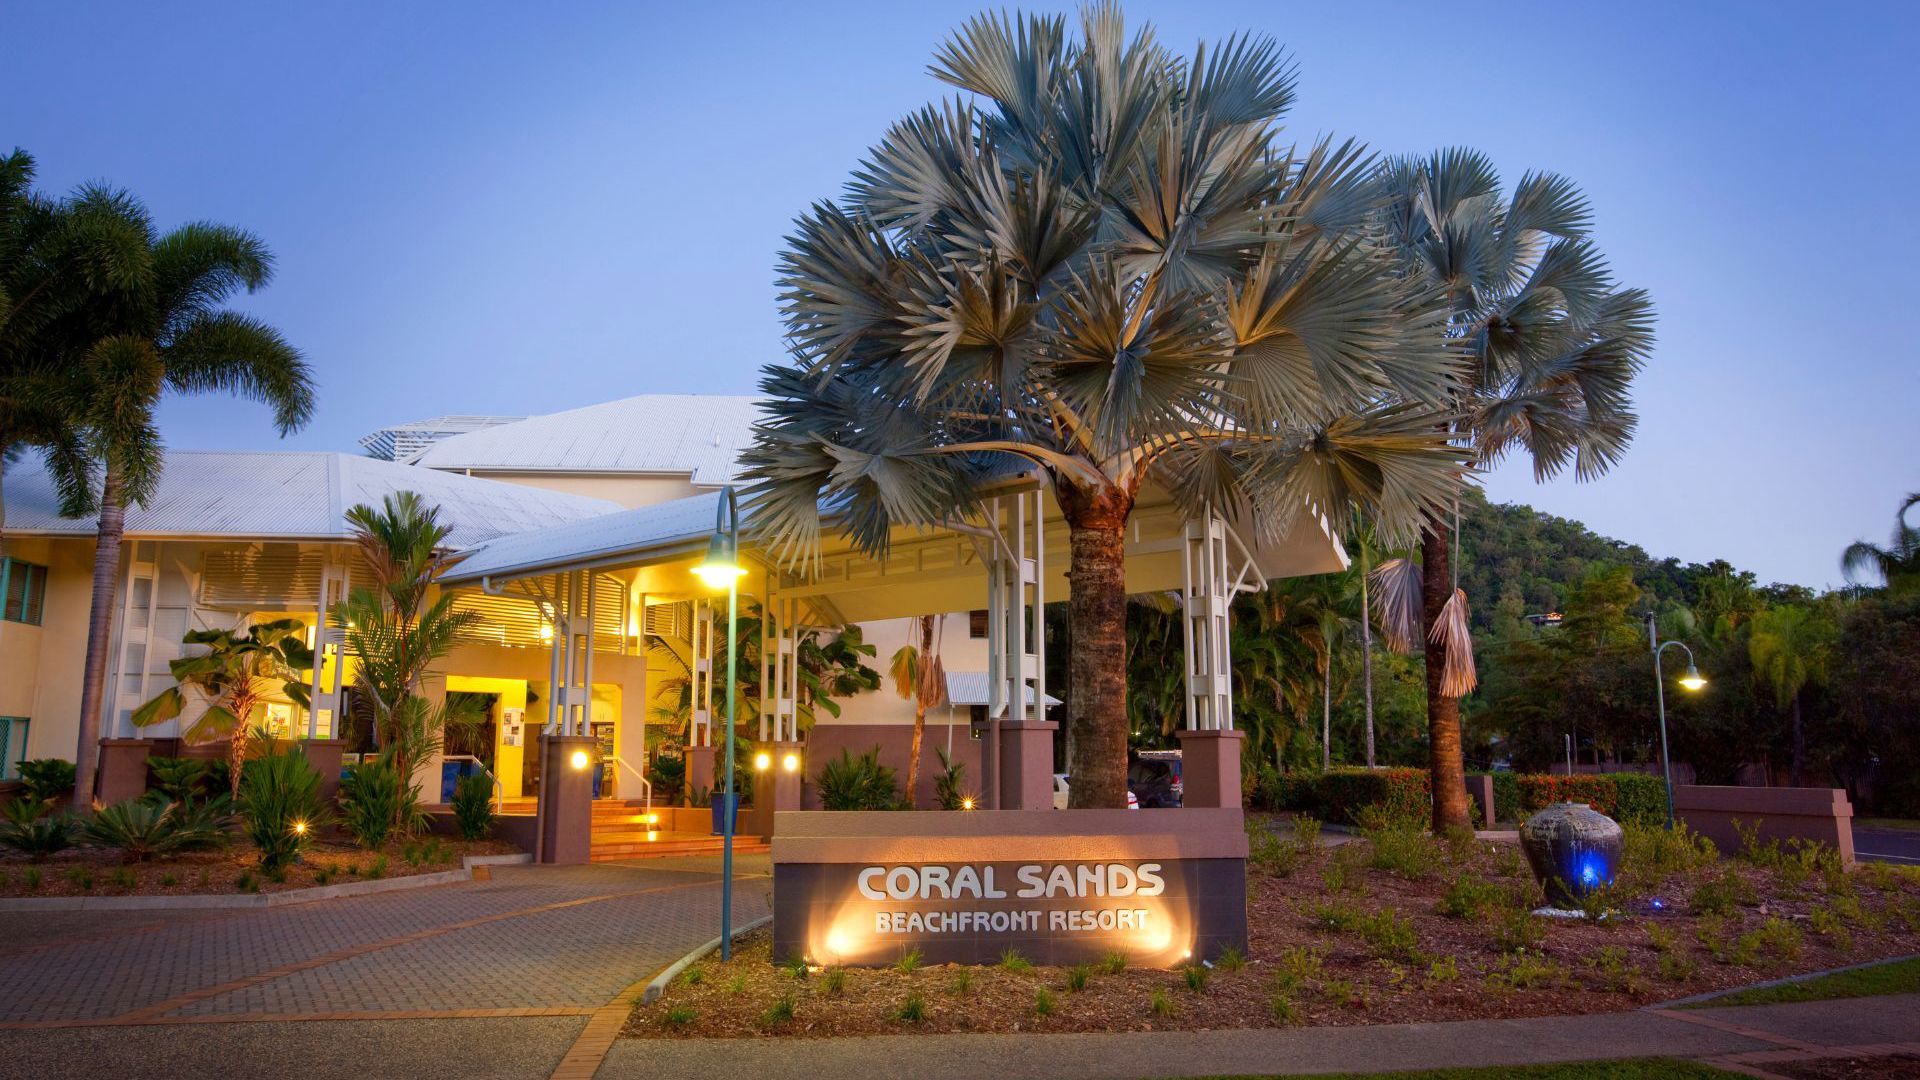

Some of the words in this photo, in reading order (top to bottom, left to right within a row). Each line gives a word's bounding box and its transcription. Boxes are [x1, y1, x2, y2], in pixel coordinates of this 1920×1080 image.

[857, 865, 1007, 900] CORAL
[1017, 863, 1165, 898] SANDS
[875, 911, 1042, 933] BEACHFRONT
[1050, 909, 1148, 931] RESORT
